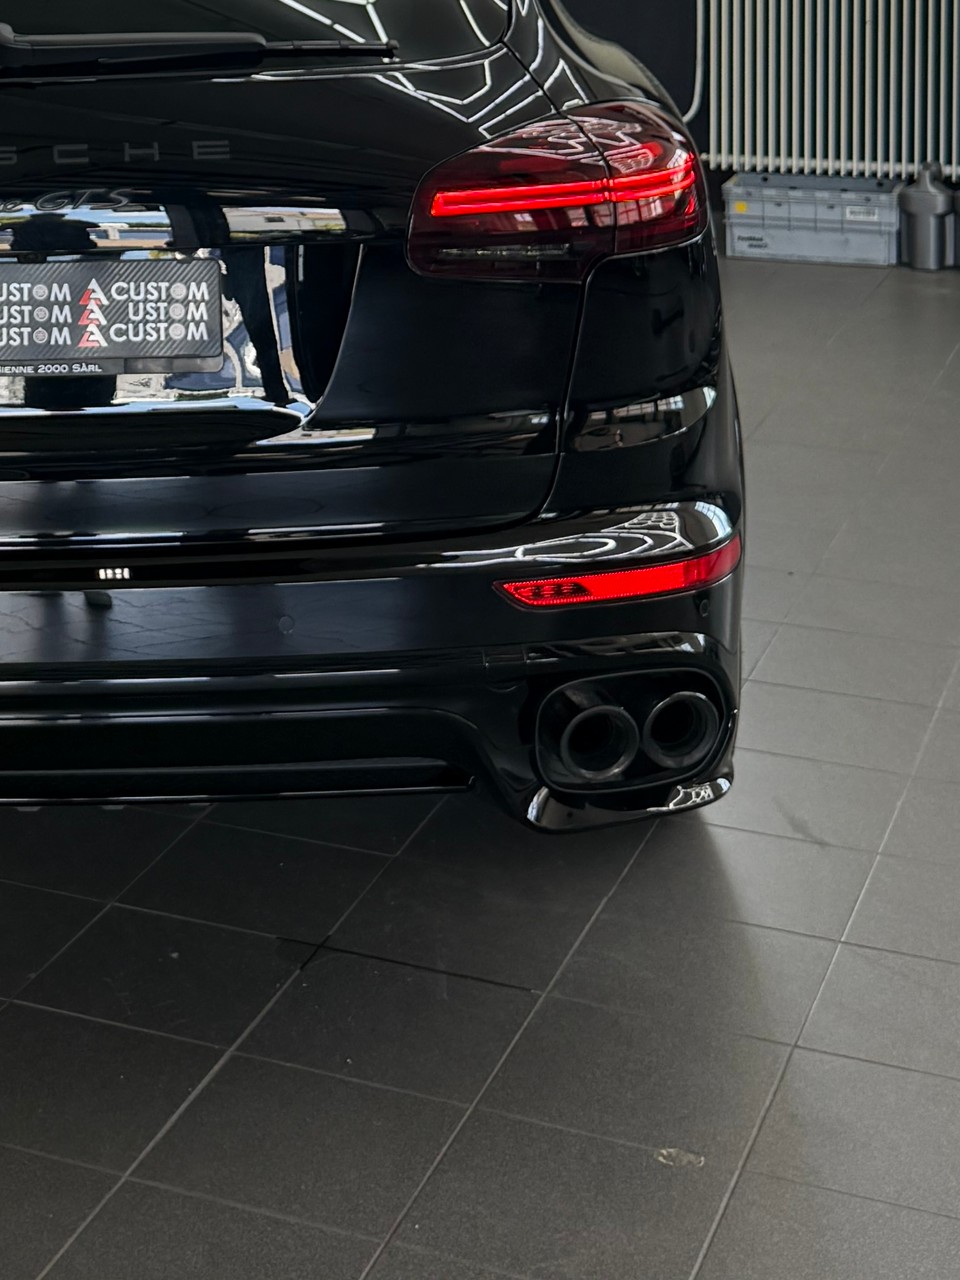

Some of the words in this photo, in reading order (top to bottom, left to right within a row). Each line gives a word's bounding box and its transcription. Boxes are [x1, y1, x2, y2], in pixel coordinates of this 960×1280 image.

[36, 188, 132, 211] GTS
[110, 281, 210, 301] CUSTOM
[109, 322, 209, 342] CUSTOM
[37, 364, 69, 373] 2000
